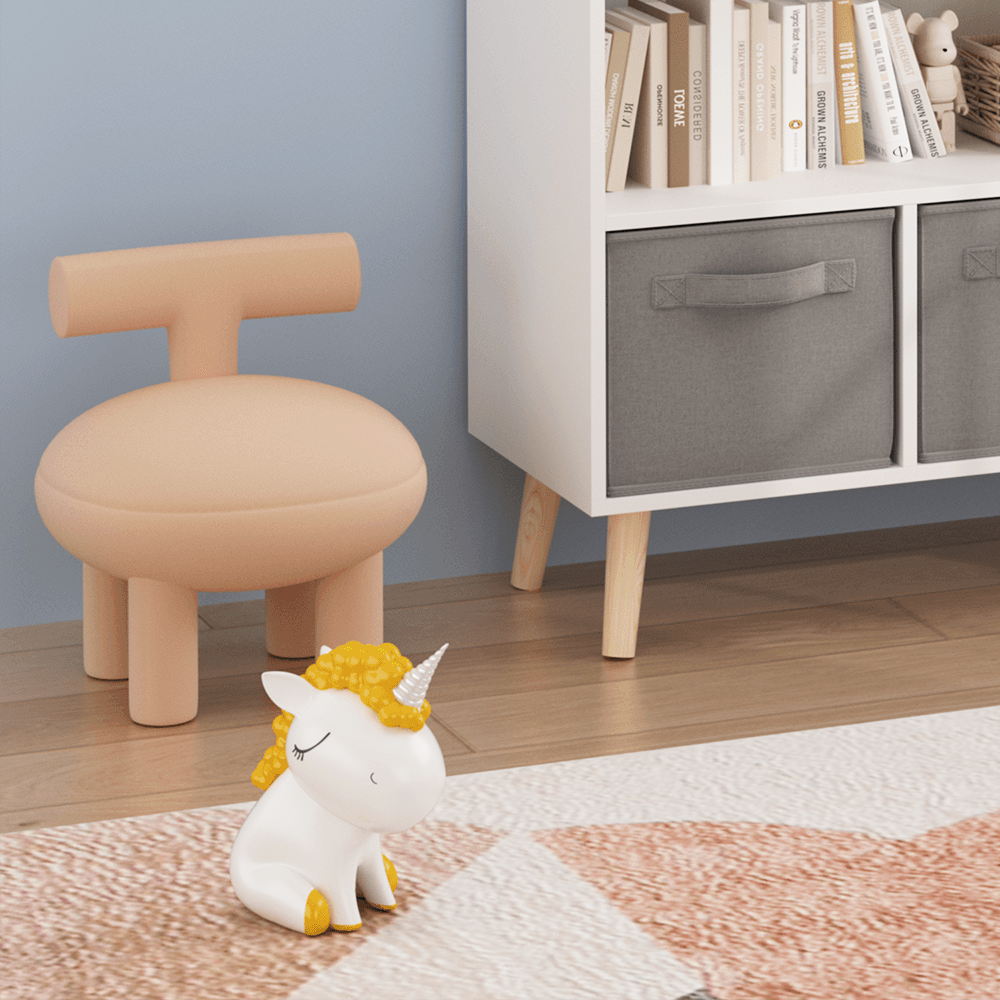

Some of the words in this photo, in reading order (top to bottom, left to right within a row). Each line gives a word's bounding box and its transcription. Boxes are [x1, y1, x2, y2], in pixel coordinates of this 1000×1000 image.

[816, 31, 827, 75] ALCHEMIST
[839, 42, 855, 60] arts
[894, 36, 915, 77] ALCHEMIST
[817, 90, 827, 123] GROWN
[841, 72, 860, 124] architecture
[910, 88, 927, 118] GROWN
[920, 119, 940, 158] ALCHEMIS
[817, 125, 827, 169] ALCHEMIS
